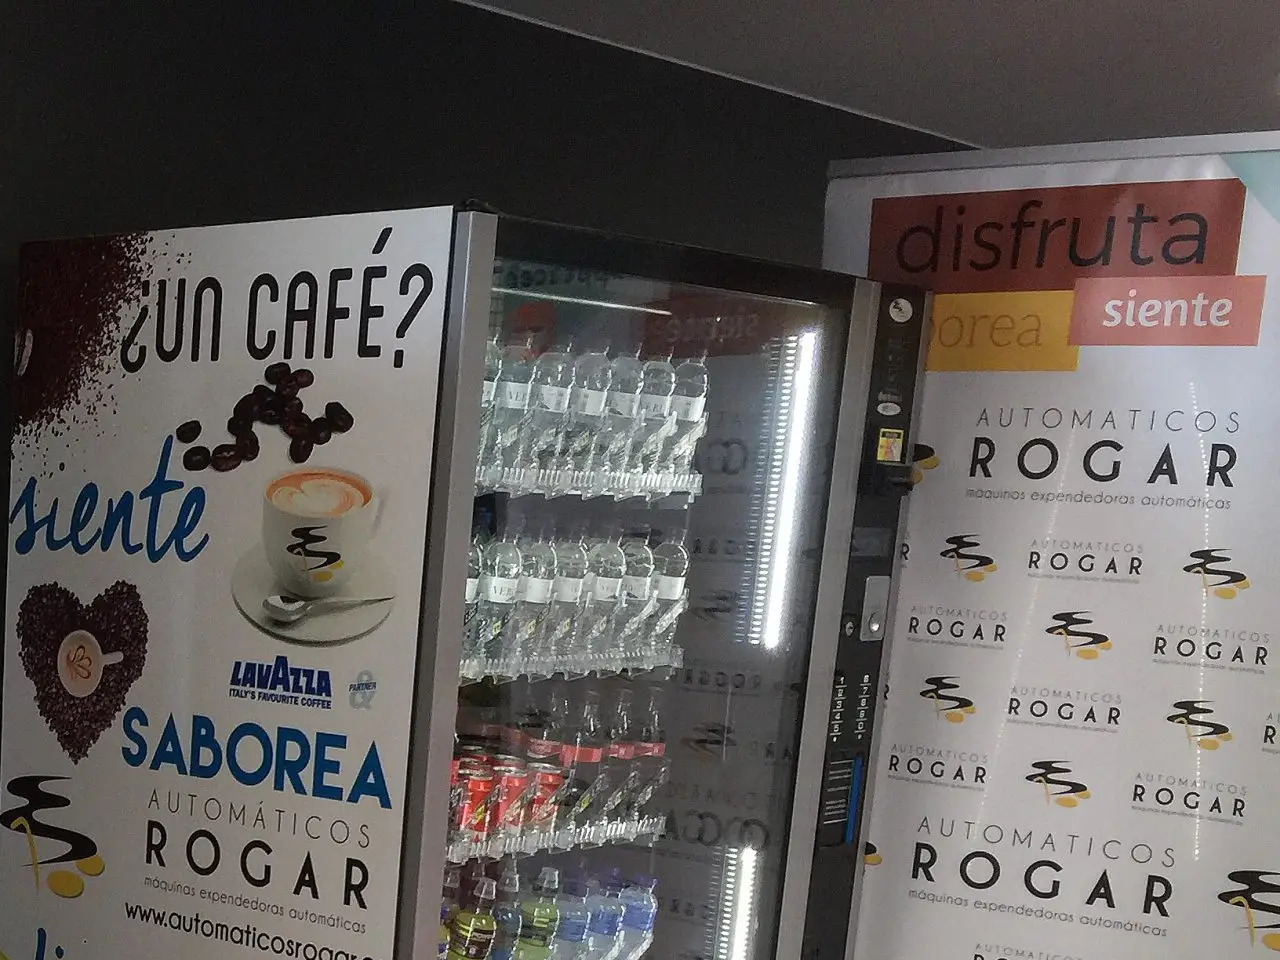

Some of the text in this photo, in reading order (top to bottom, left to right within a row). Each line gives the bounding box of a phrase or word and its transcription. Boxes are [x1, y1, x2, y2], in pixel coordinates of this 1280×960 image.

[895, 200, 1209, 273] disfruta
[120, 227, 434, 373] ¿UN CAFÉ?
[1102, 289, 1233, 329] siente
[976, 407, 1240, 433] AUTOMATICOS
[968, 436, 1238, 488] ROGAR
[9, 434, 210, 563] siente
[1031, 488, 1135, 507] expendedoras
[1027, 551, 1143, 576] ROGAR
[1030, 538, 1145, 554] AUTOMATICOS
[908, 616, 1006, 642] ROGAR
[910, 605, 1008, 621] AUTOMATICOS
[229, 655, 332, 697] LAVAZZA
[229, 688, 332, 709] ITALY'S FAVOURITE COFFEE
[121, 706, 392, 810] SABOREA
[147, 788, 370, 849] AUTOMÁTICOS
[917, 815, 1175, 869] AUTOMATICOS
[145, 819, 370, 910] ROGAR
[911, 841, 1173, 918] ROGAR
[144, 876, 366, 934] máquinas expendedoras automáticas
[907, 887, 1168, 938] máquinas expendedoras automáticas
